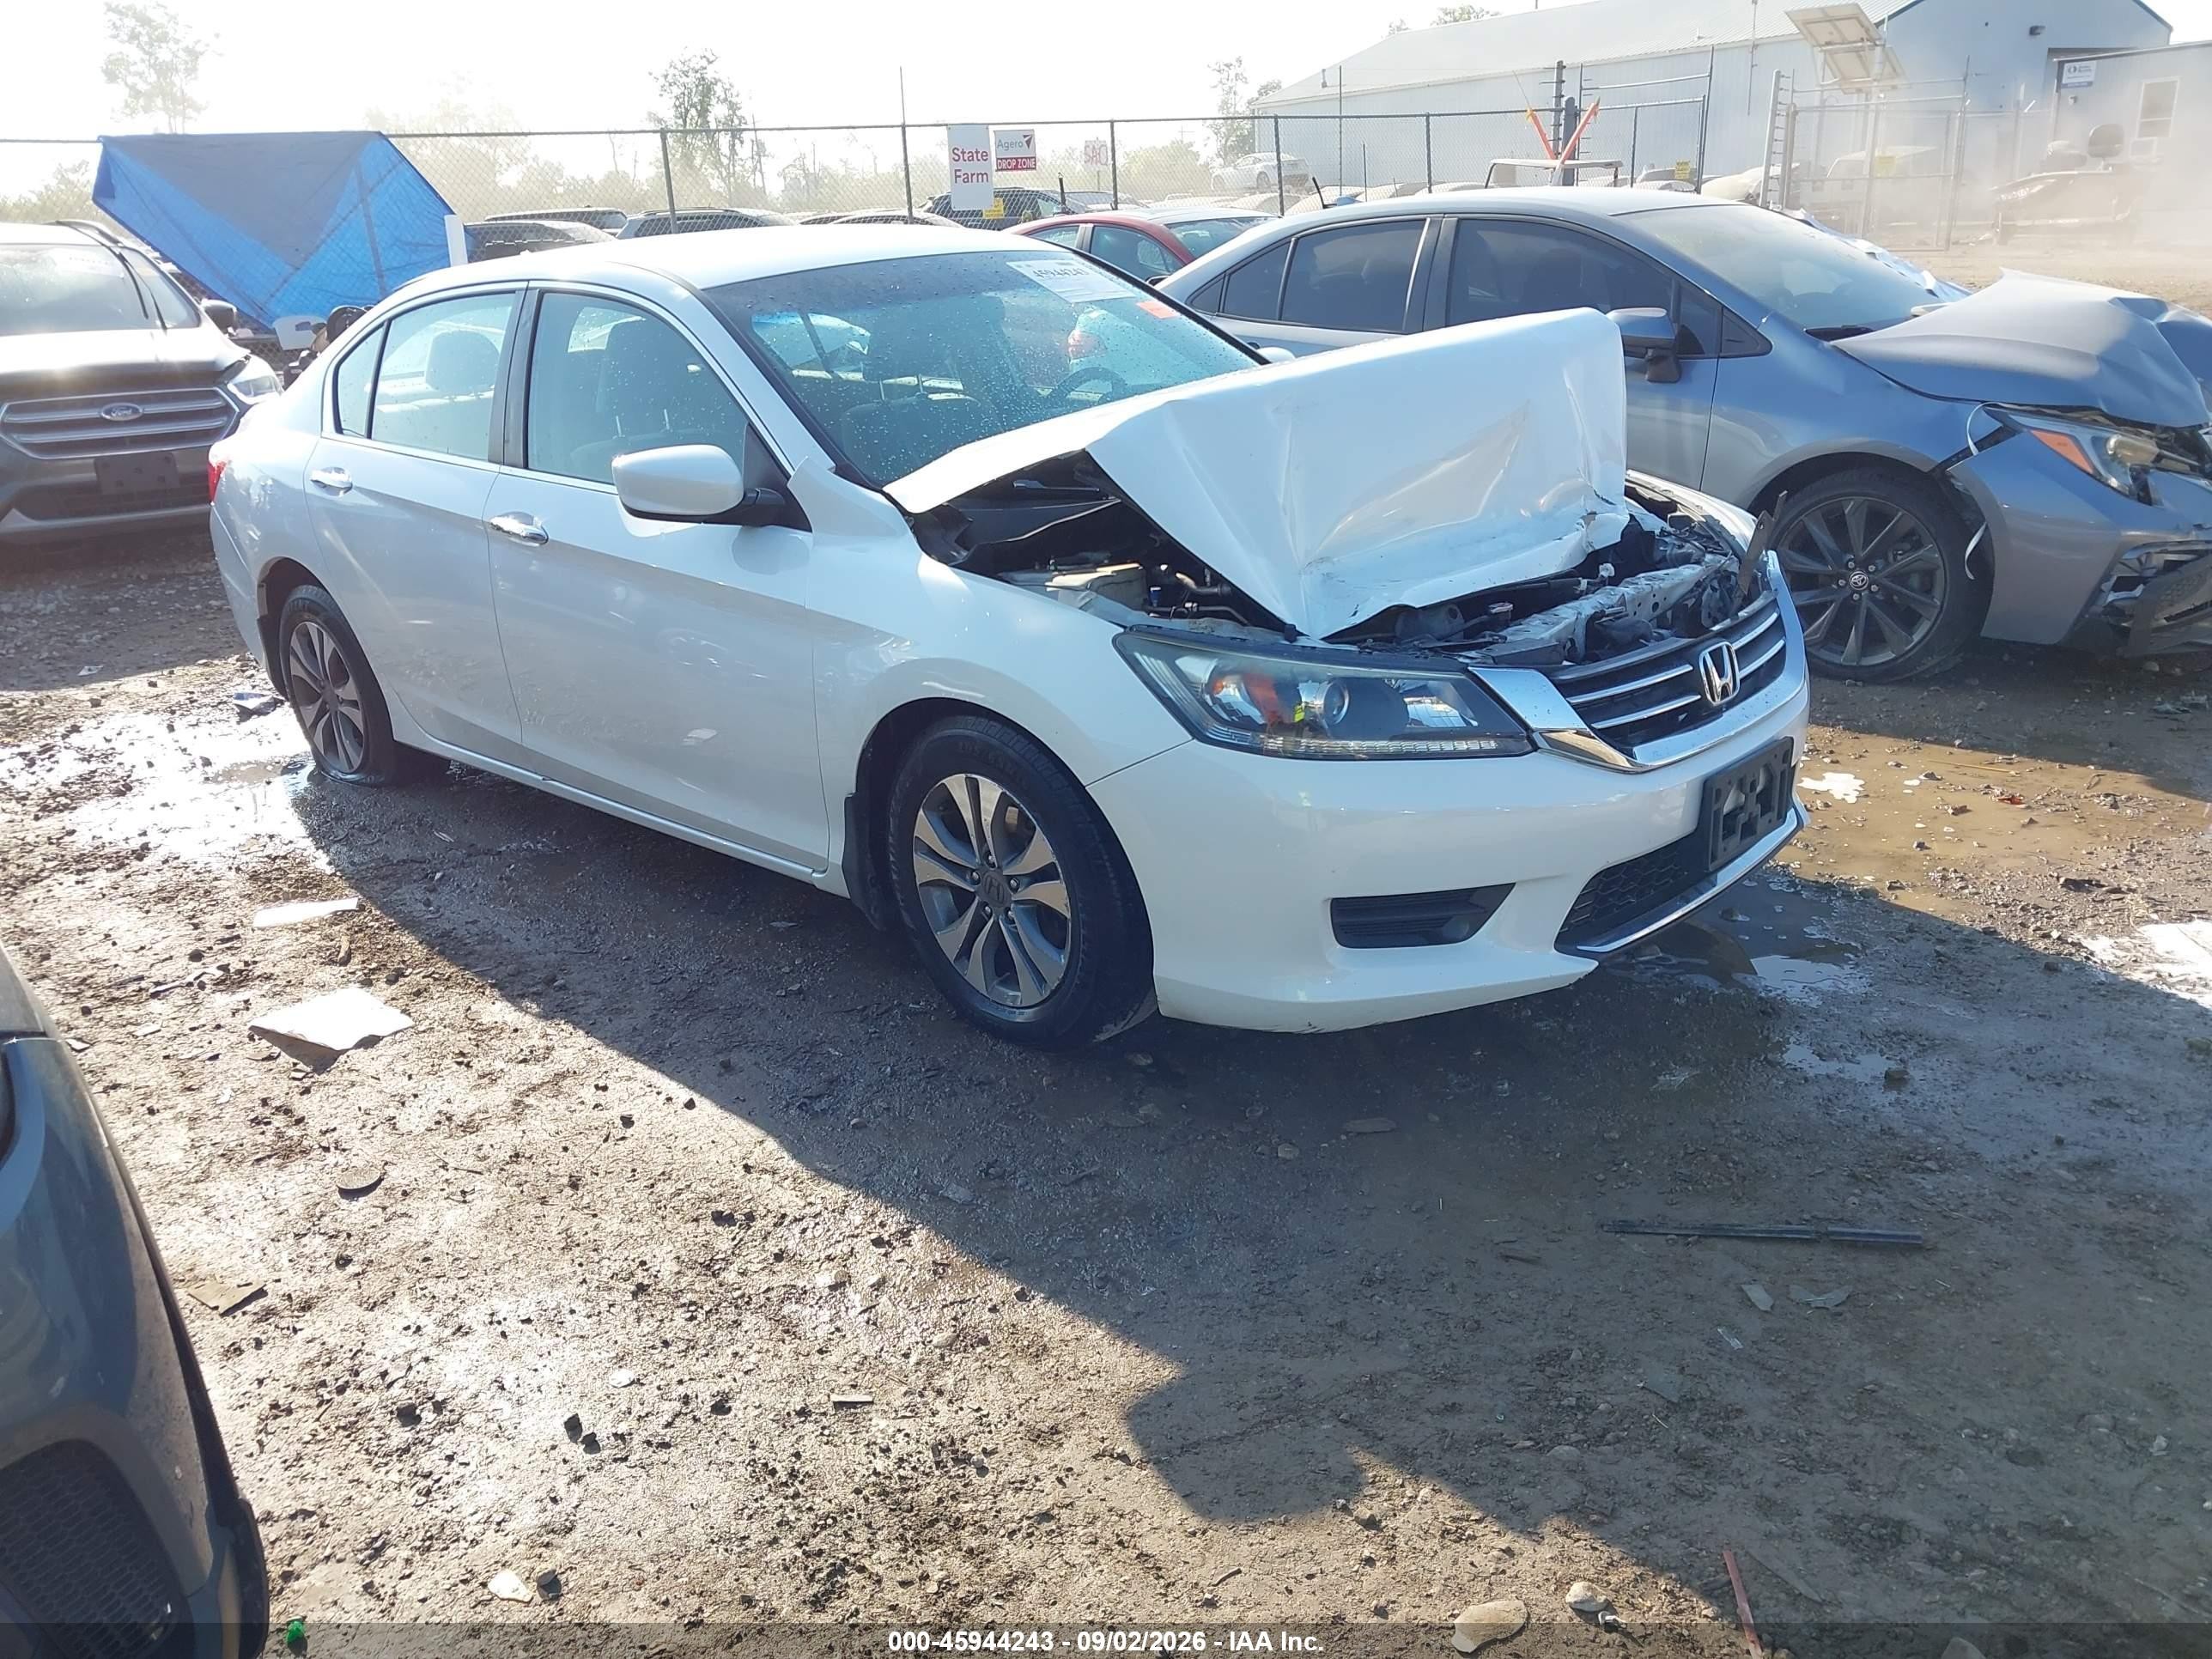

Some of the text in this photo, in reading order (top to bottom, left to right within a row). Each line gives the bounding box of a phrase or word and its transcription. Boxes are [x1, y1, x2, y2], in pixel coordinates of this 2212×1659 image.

[997, 139, 1024, 151] Agero
[952, 147, 988, 162] State
[997, 158, 1036, 169] DROP ZONE
[954, 168, 989, 184] Farm
